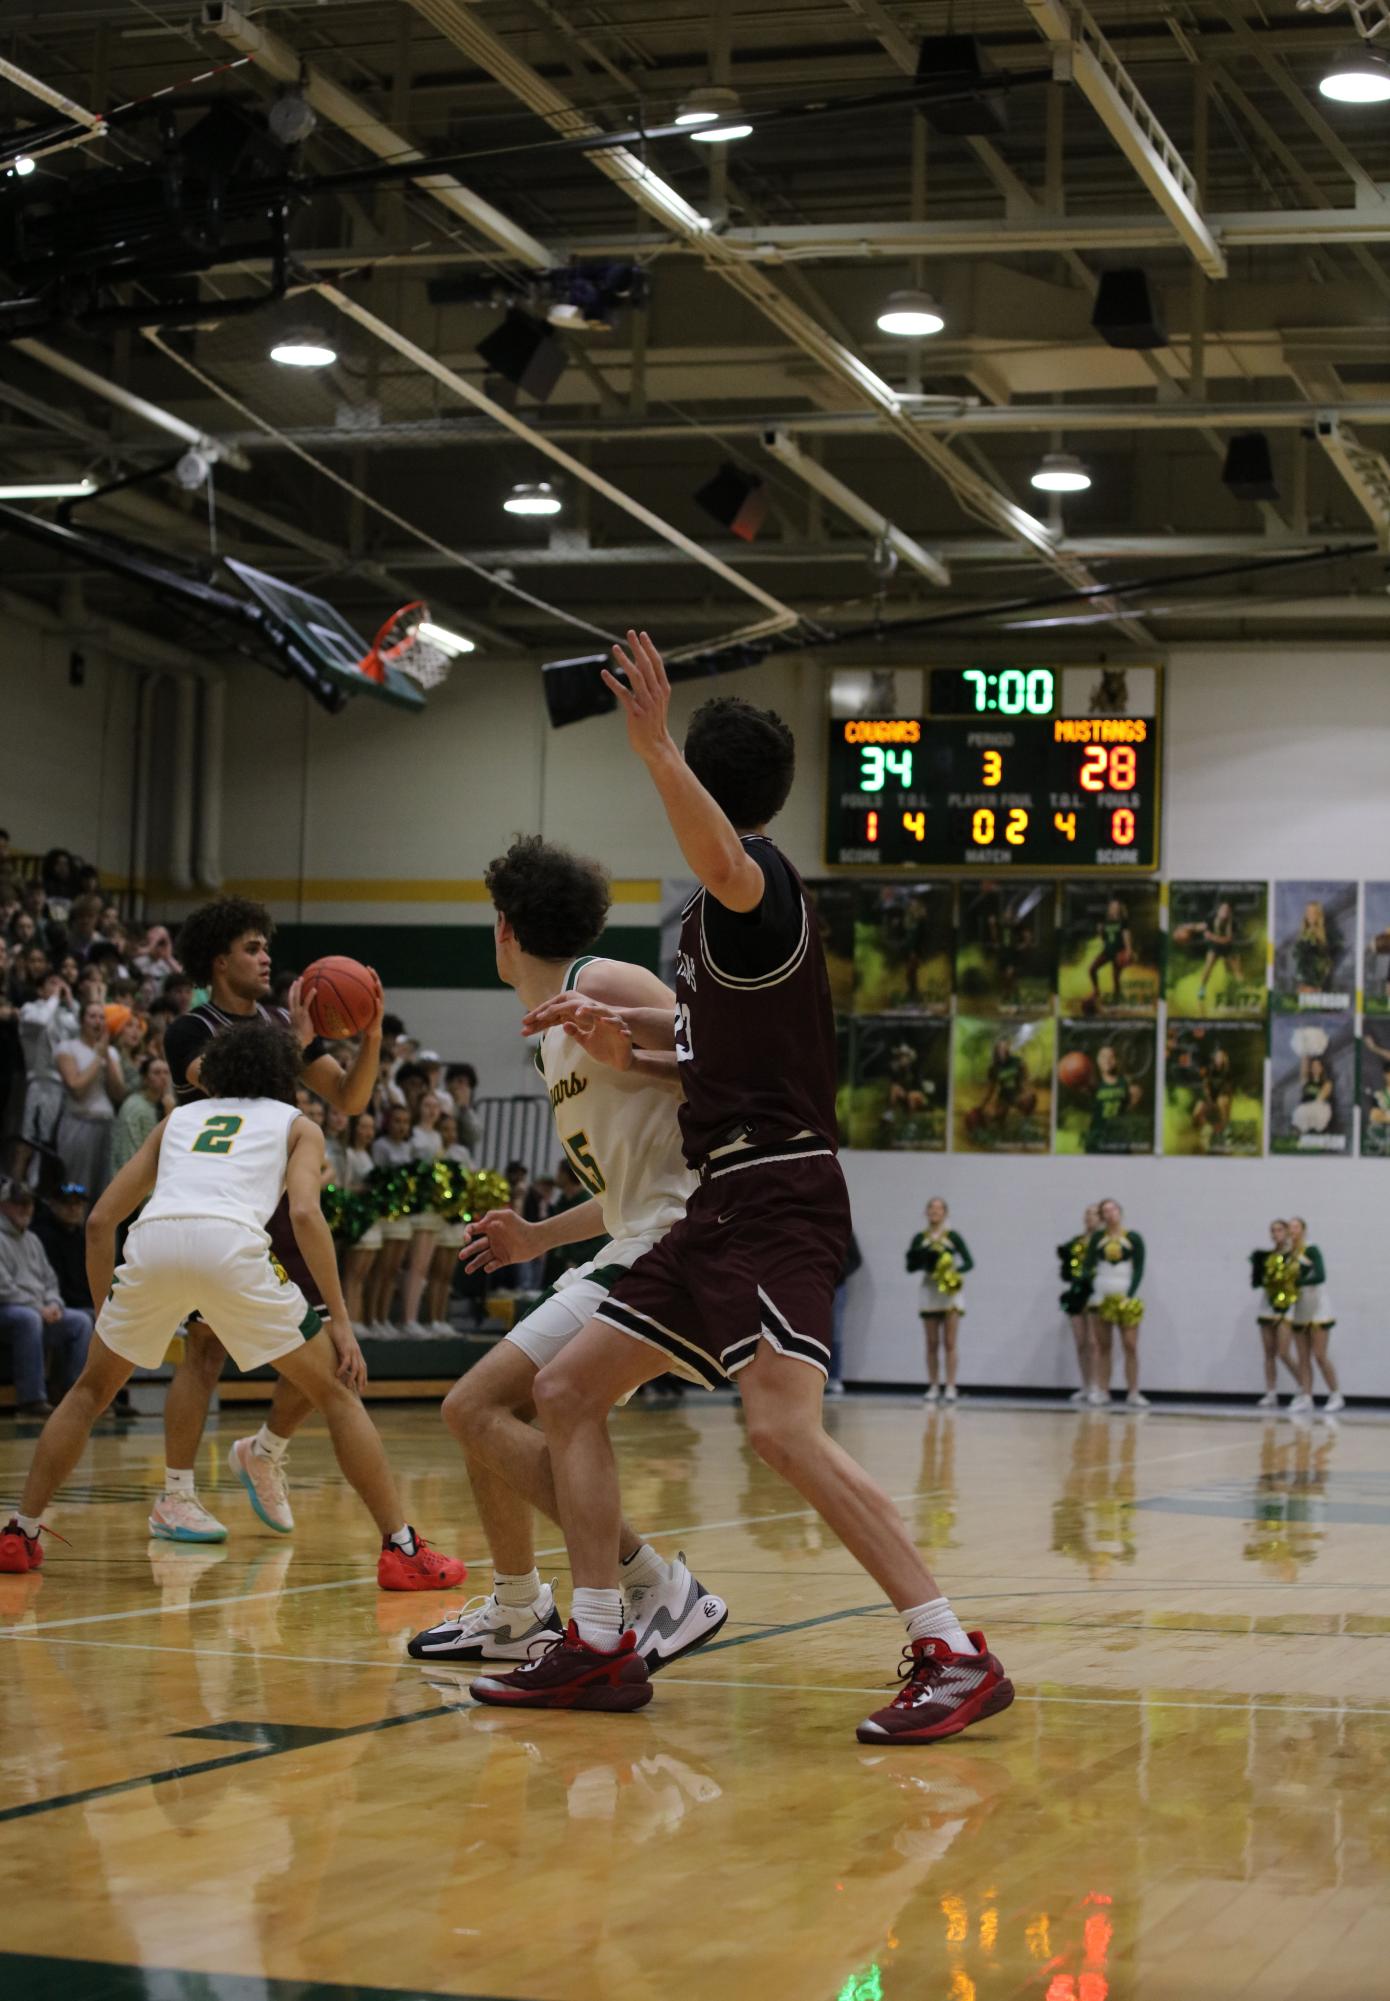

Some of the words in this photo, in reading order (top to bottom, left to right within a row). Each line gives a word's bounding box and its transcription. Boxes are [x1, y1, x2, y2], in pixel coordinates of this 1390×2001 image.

[962, 669, 1053, 714] 7:00
[1054, 719, 1146, 742] MUSTANGS
[860, 746, 912, 791] 34
[983, 750, 1002, 786] 3
[1080, 745, 1136, 791] 28
[867, 811, 878, 842] 1
[903, 811, 925, 841] 4
[1054, 811, 1076, 841] 4
[1112, 808, 1135, 845] 0
[190, 1113, 244, 1154] 2
